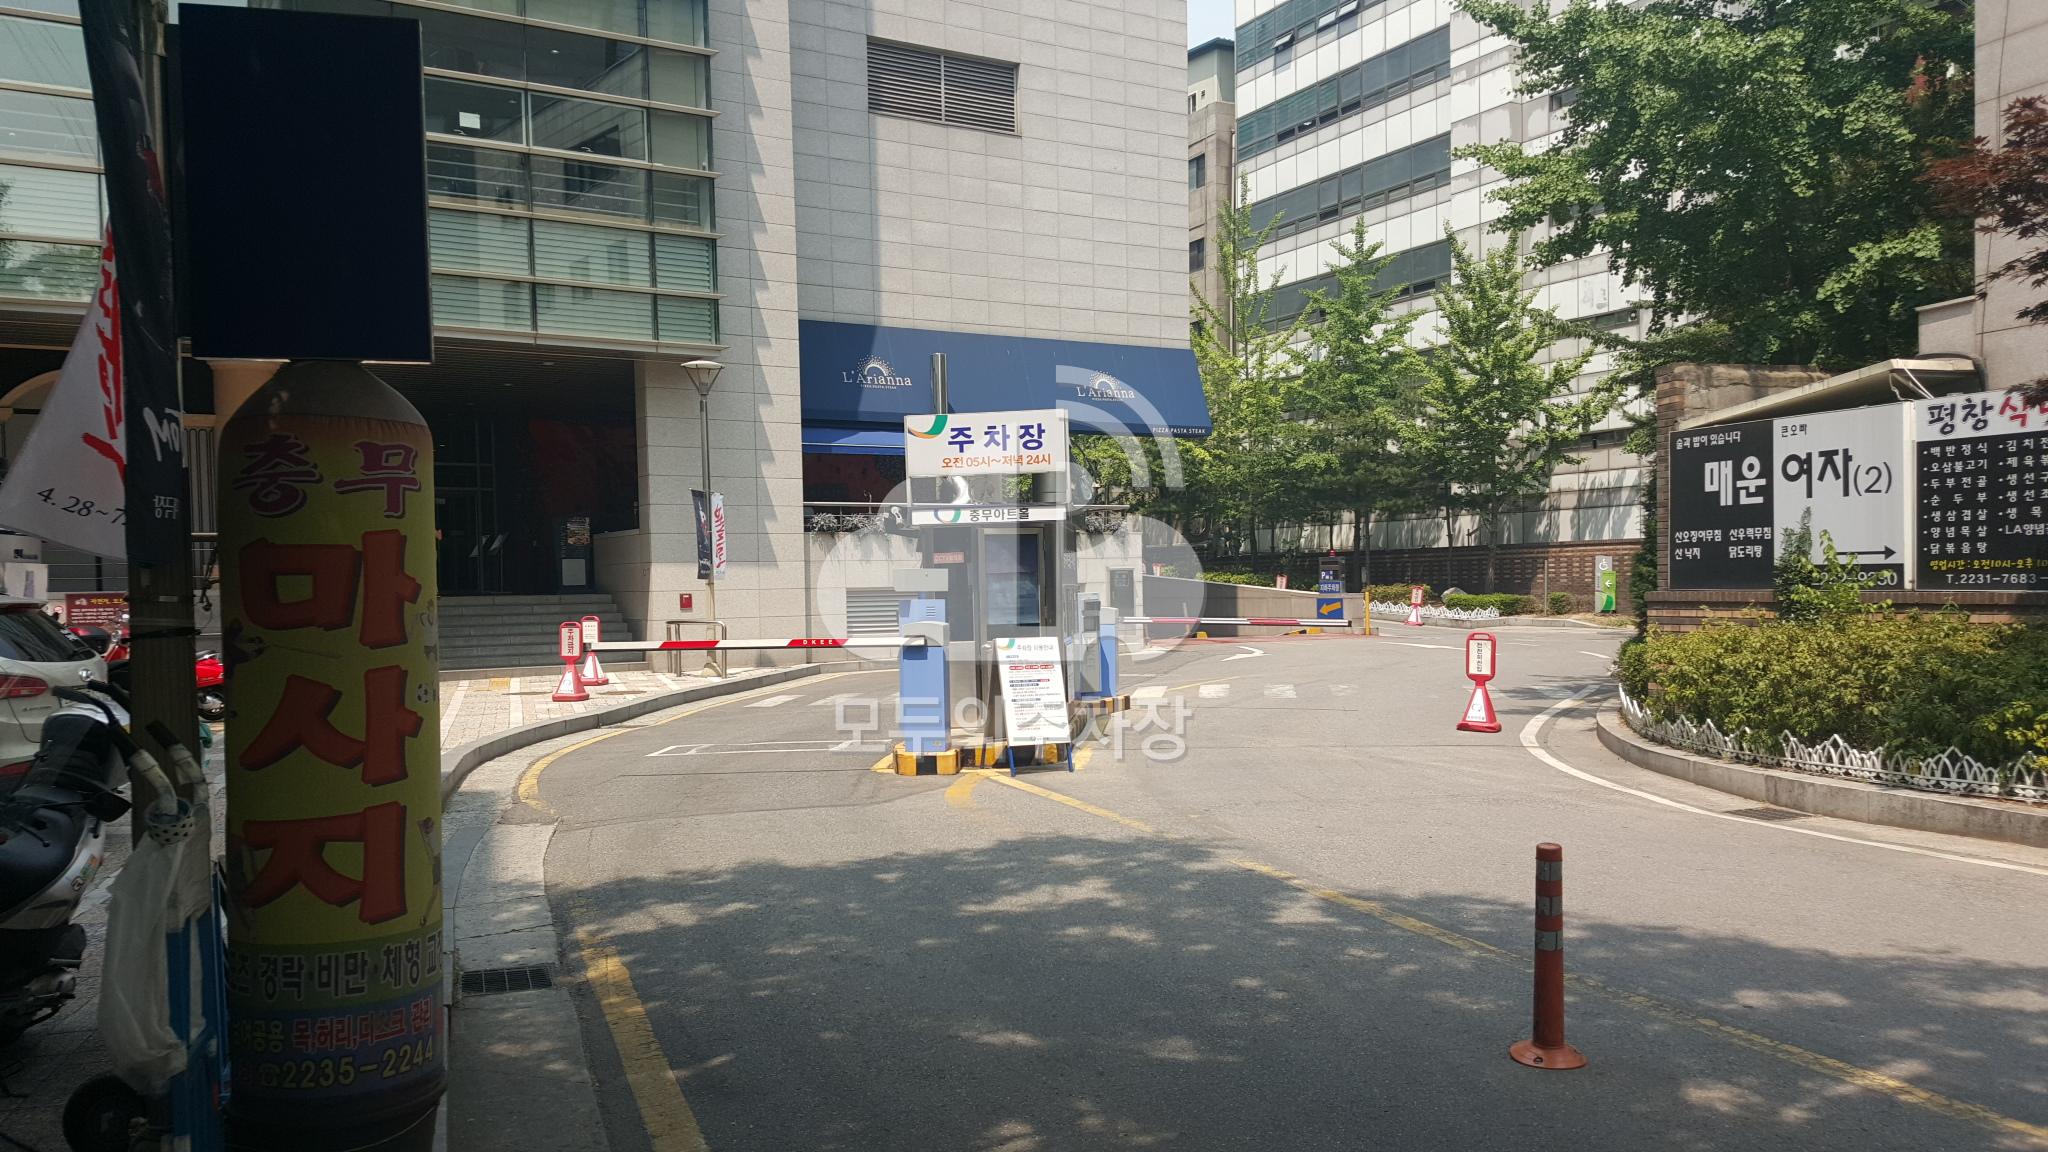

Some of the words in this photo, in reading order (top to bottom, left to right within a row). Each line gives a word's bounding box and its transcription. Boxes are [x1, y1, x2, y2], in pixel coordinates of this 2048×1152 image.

[947, 423, 1046, 453] 주차장
[1693, 435, 1708, 448] 밥이
[1710, 431, 1741, 446] 있습니다
[941, 457, 964, 468] 오전
[1026, 453, 1051, 465] 24시
[1930, 459, 1988, 474] 오삼불고기
[233, 431, 422, 518] 충무
[1704, 455, 1767, 506] 매운
[1675, 529, 1722, 543] 산오징어무침
[1729, 527, 1772, 541] 산우럭무침
[1728, 545, 1762, 559] 닭도리탕
[258, 953, 305, 1001] 경락
[316, 951, 370, 998] 비만
[381, 939, 421, 988] 체형
